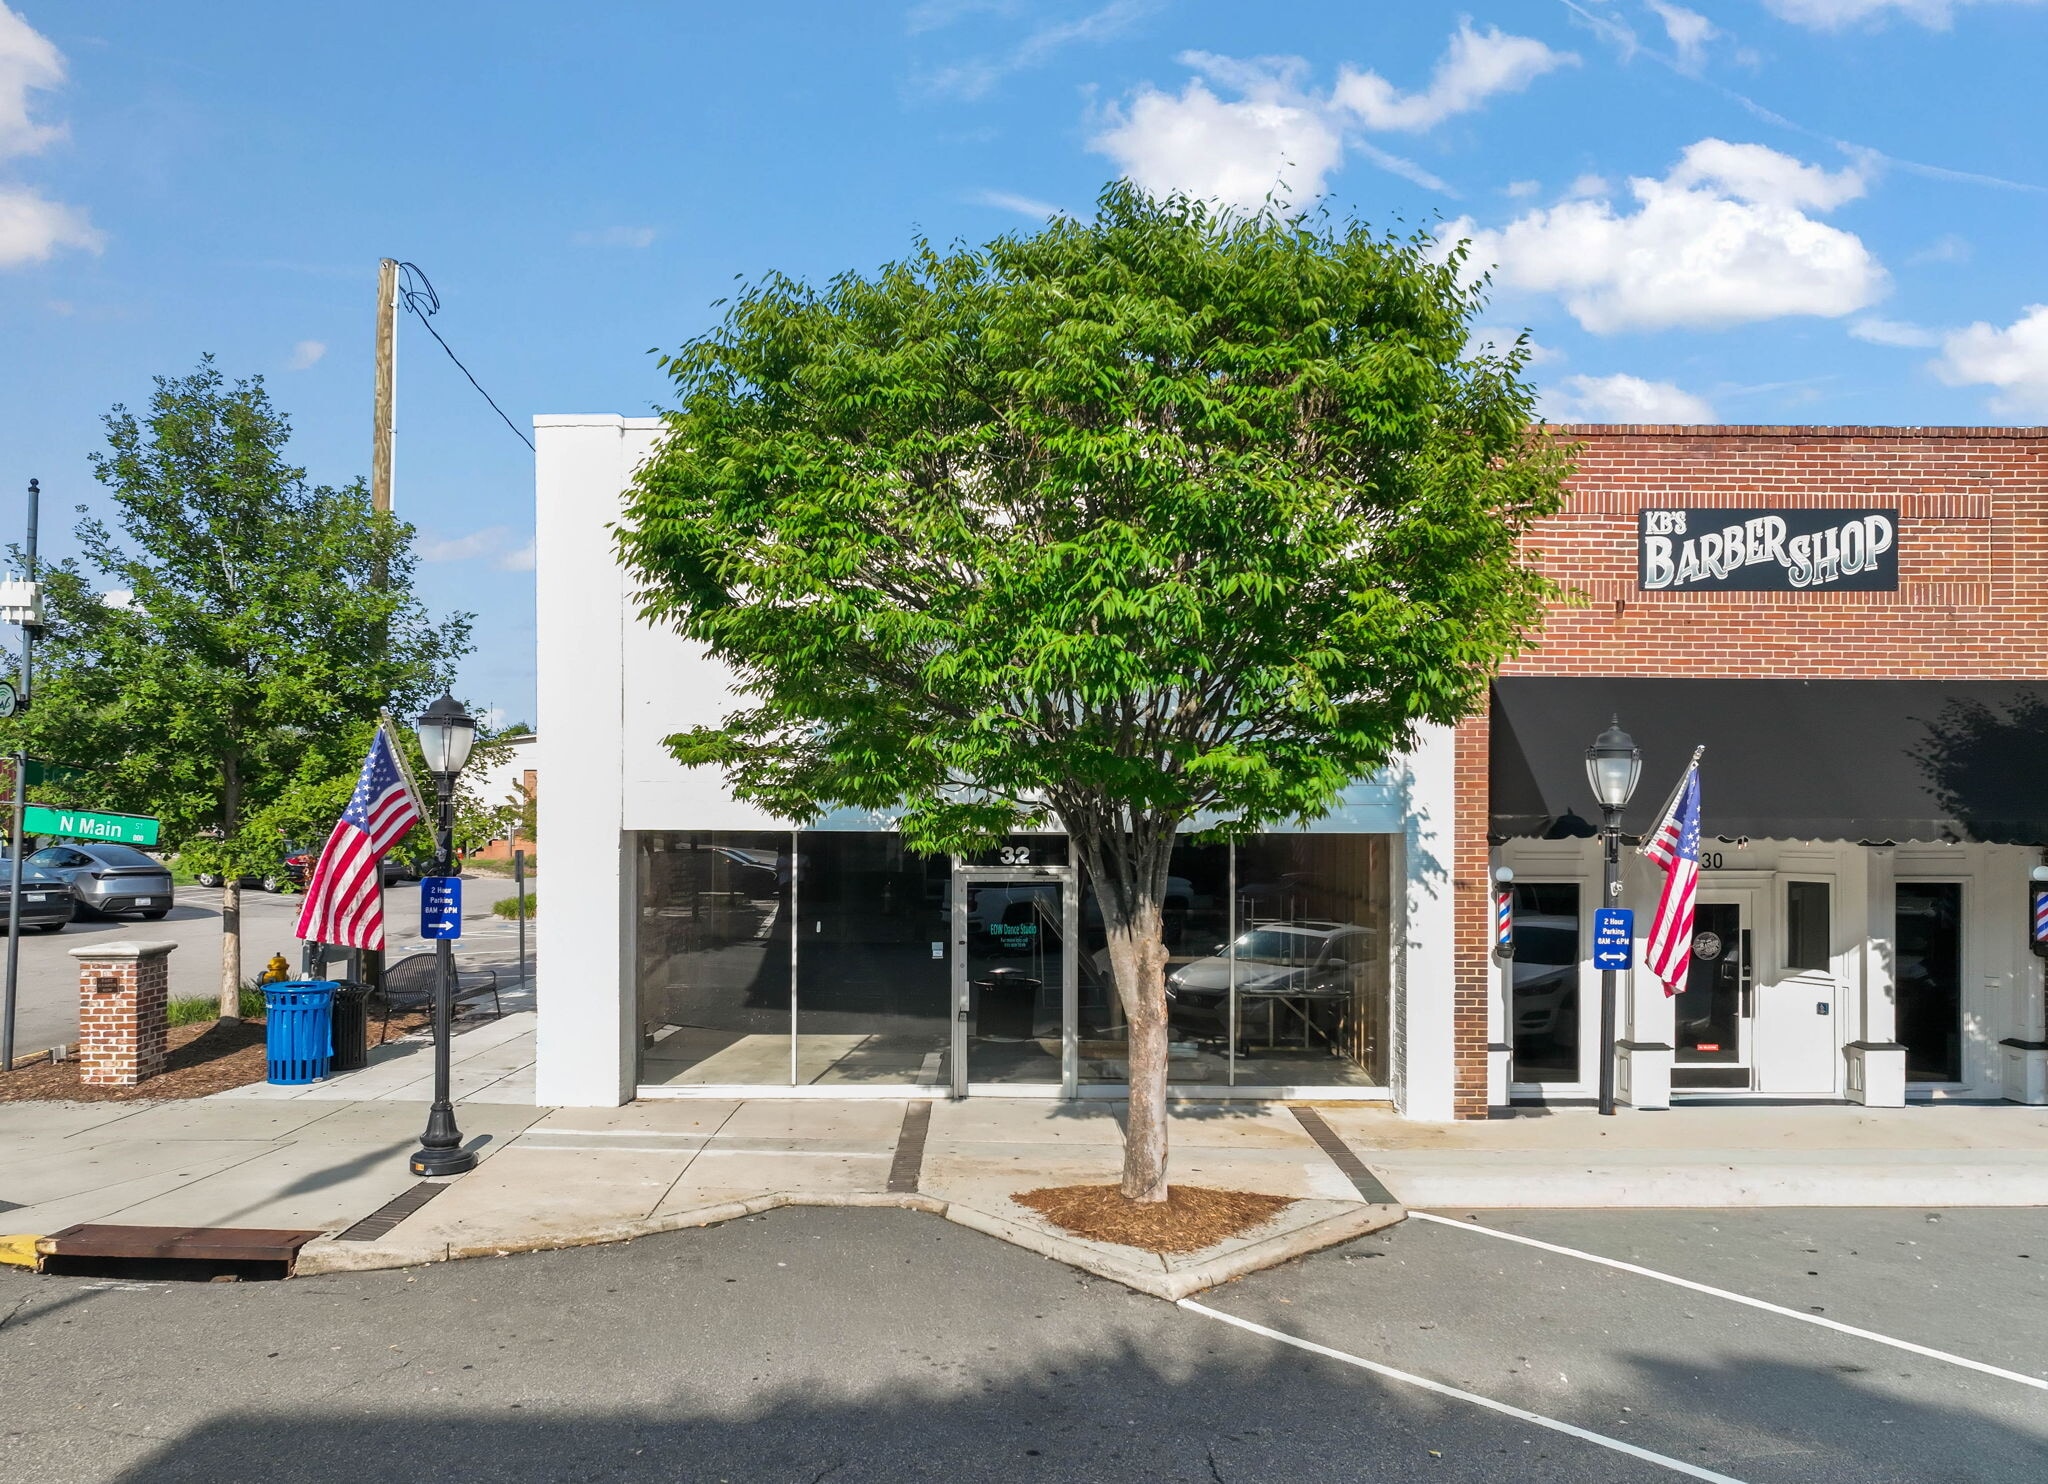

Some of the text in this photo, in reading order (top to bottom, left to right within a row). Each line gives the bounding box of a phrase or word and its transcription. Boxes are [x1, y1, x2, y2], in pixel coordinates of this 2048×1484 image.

[1645, 510, 1687, 535] KB'S
[1645, 514, 1893, 589] BARBER SHOP
[59, 815, 74, 832] N
[79, 818, 122, 838] Main
[1000, 846, 1030, 865] 32
[1701, 852, 1723, 869] 30
[430, 896, 453, 905] Parking
[1004, 923, 1020, 935] Dance
[1020, 922, 1037, 935] Studio
[1602, 928, 1625, 936] Parking
